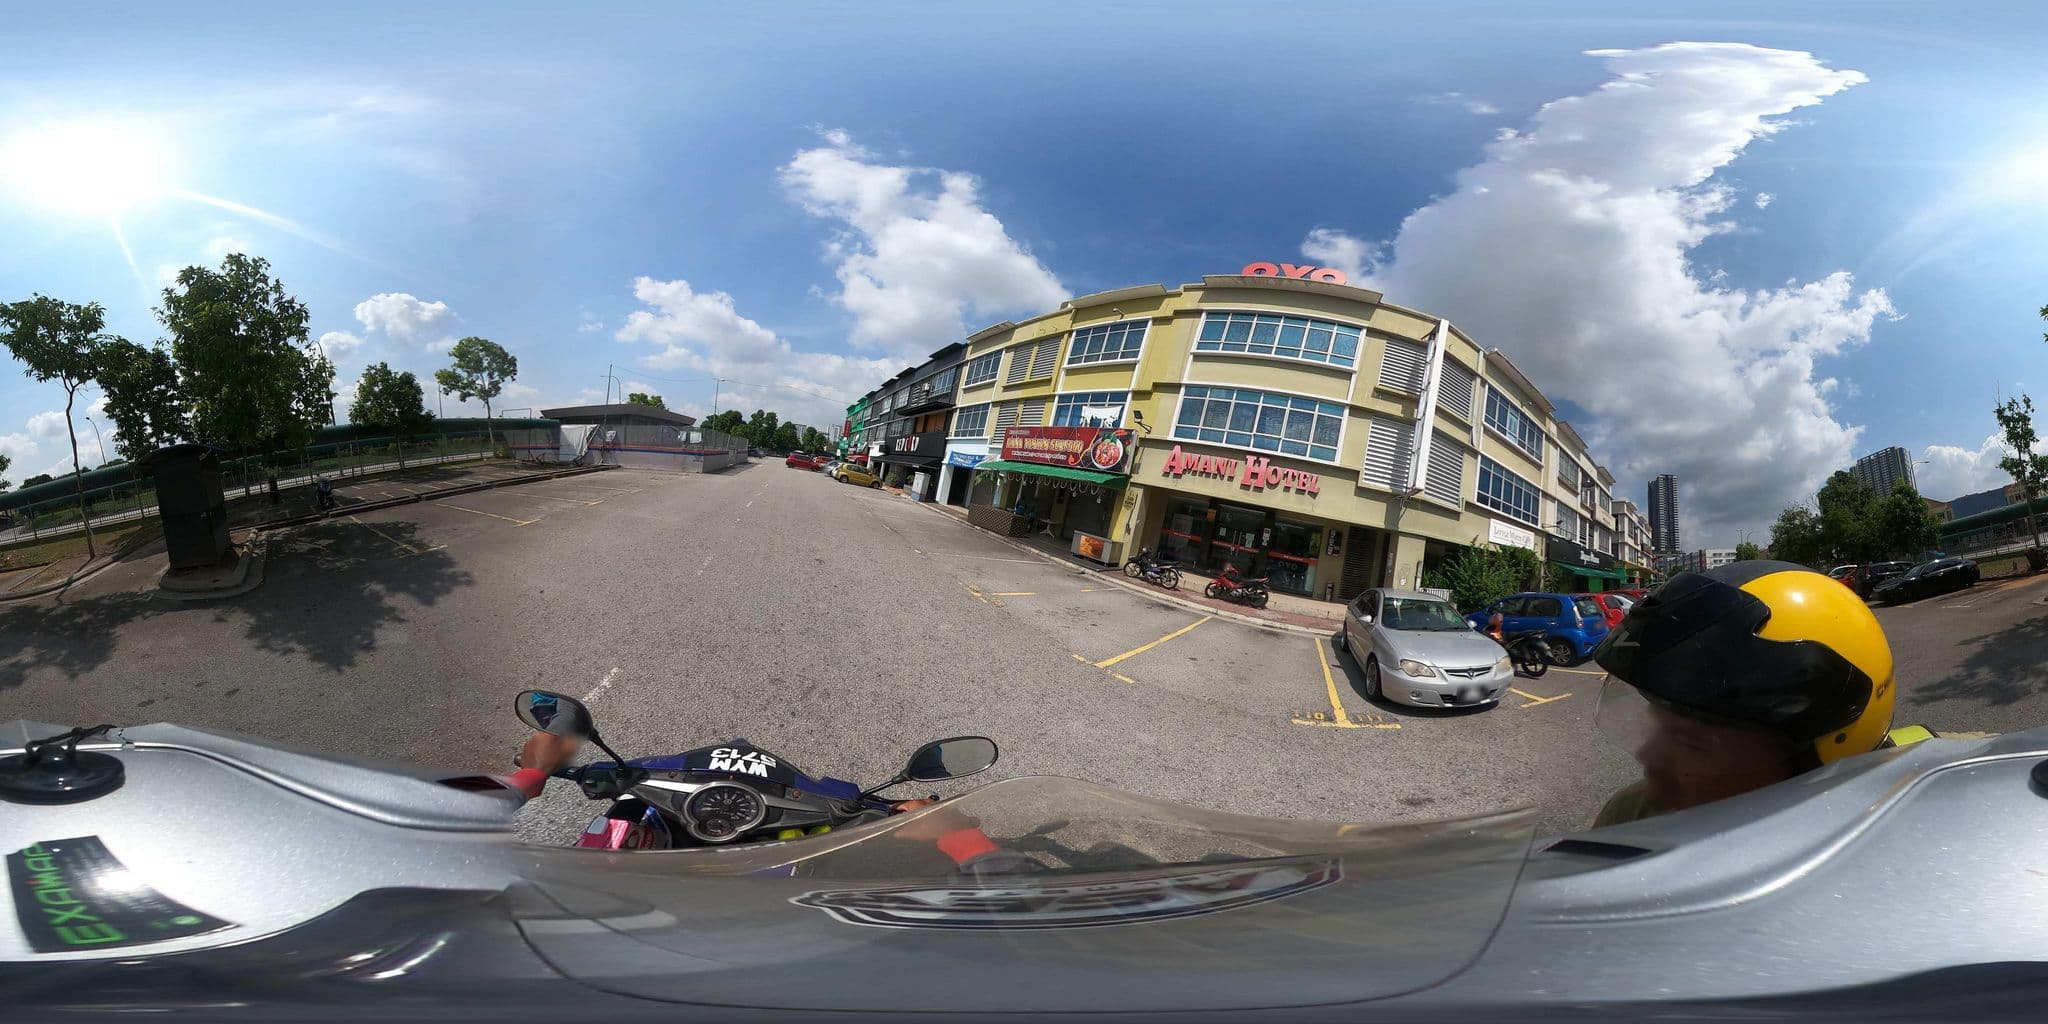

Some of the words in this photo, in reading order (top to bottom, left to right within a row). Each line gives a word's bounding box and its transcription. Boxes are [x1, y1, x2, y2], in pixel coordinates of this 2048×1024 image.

[1242, 262, 1347, 285] OYO
[709, 757, 768, 777] WYM
[711, 748, 776, 768] 5713
